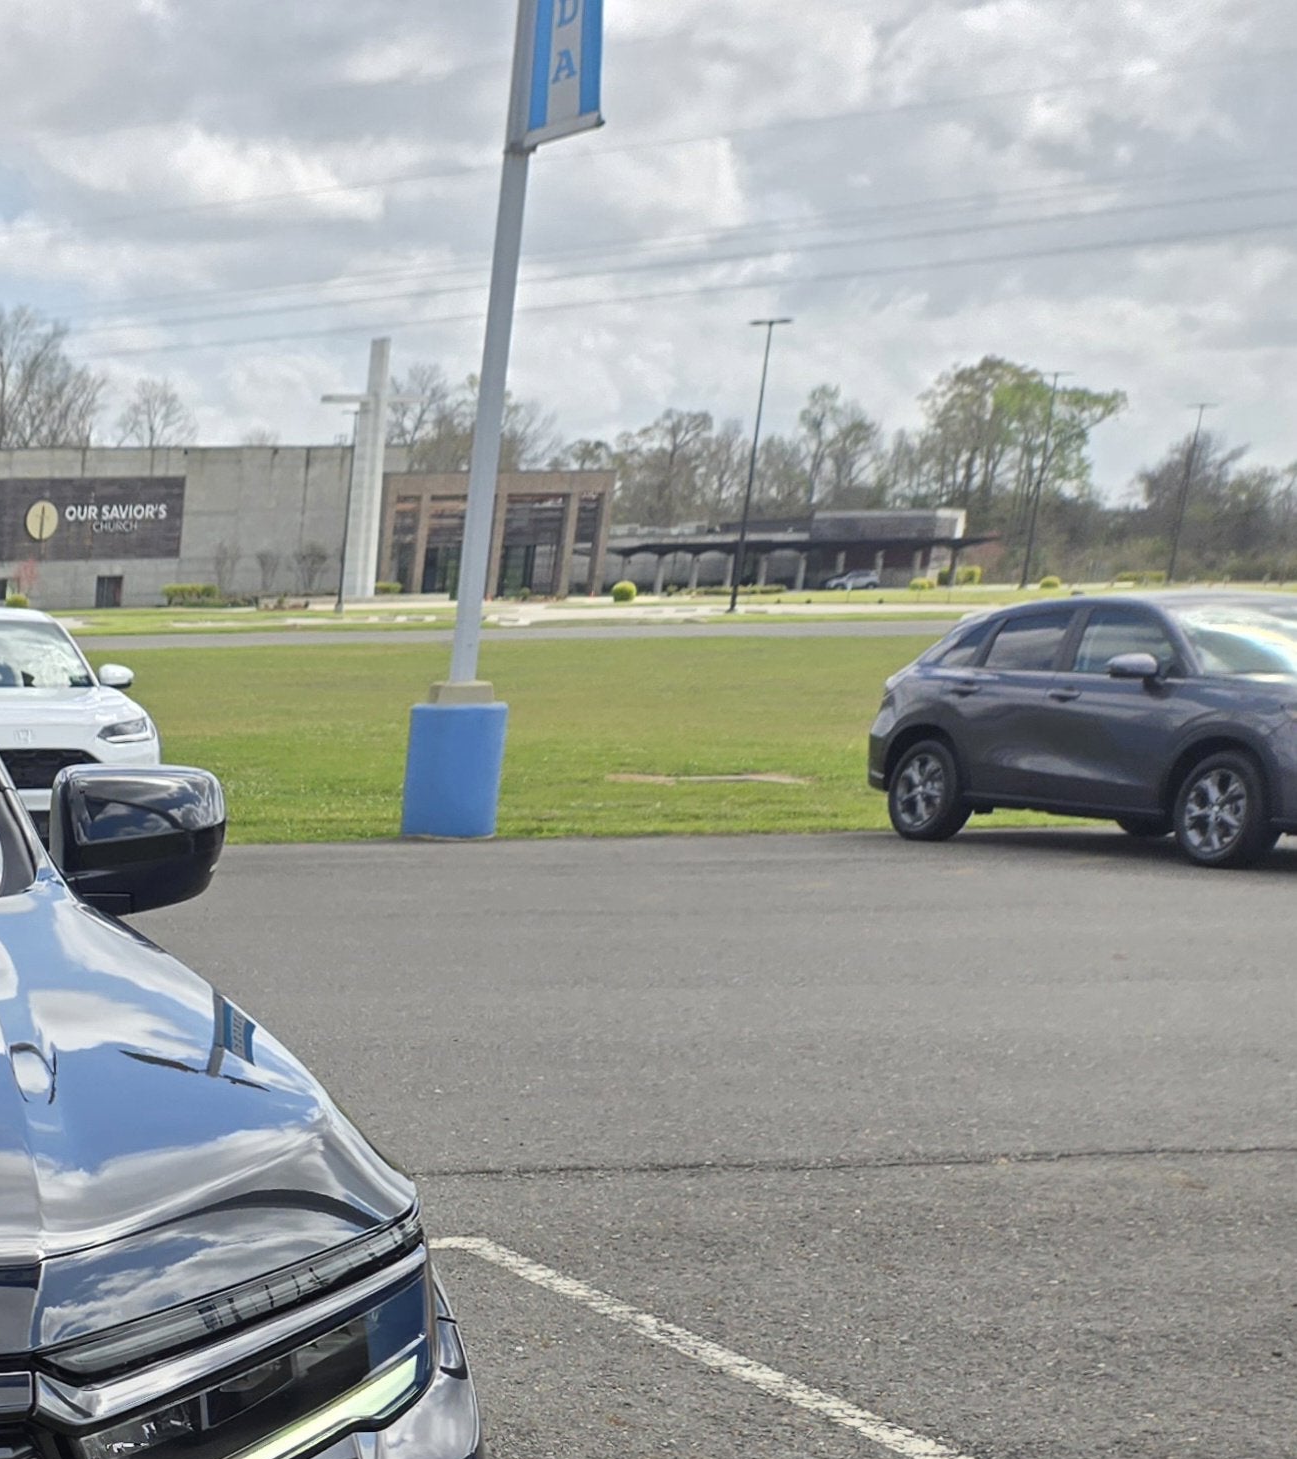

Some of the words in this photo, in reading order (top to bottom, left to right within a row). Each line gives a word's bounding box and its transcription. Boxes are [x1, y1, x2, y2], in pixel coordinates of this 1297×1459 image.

[64, 504, 99, 521] OUR
[100, 503, 168, 520] SAVIOR'S
[92, 520, 138, 533] CHURCH
